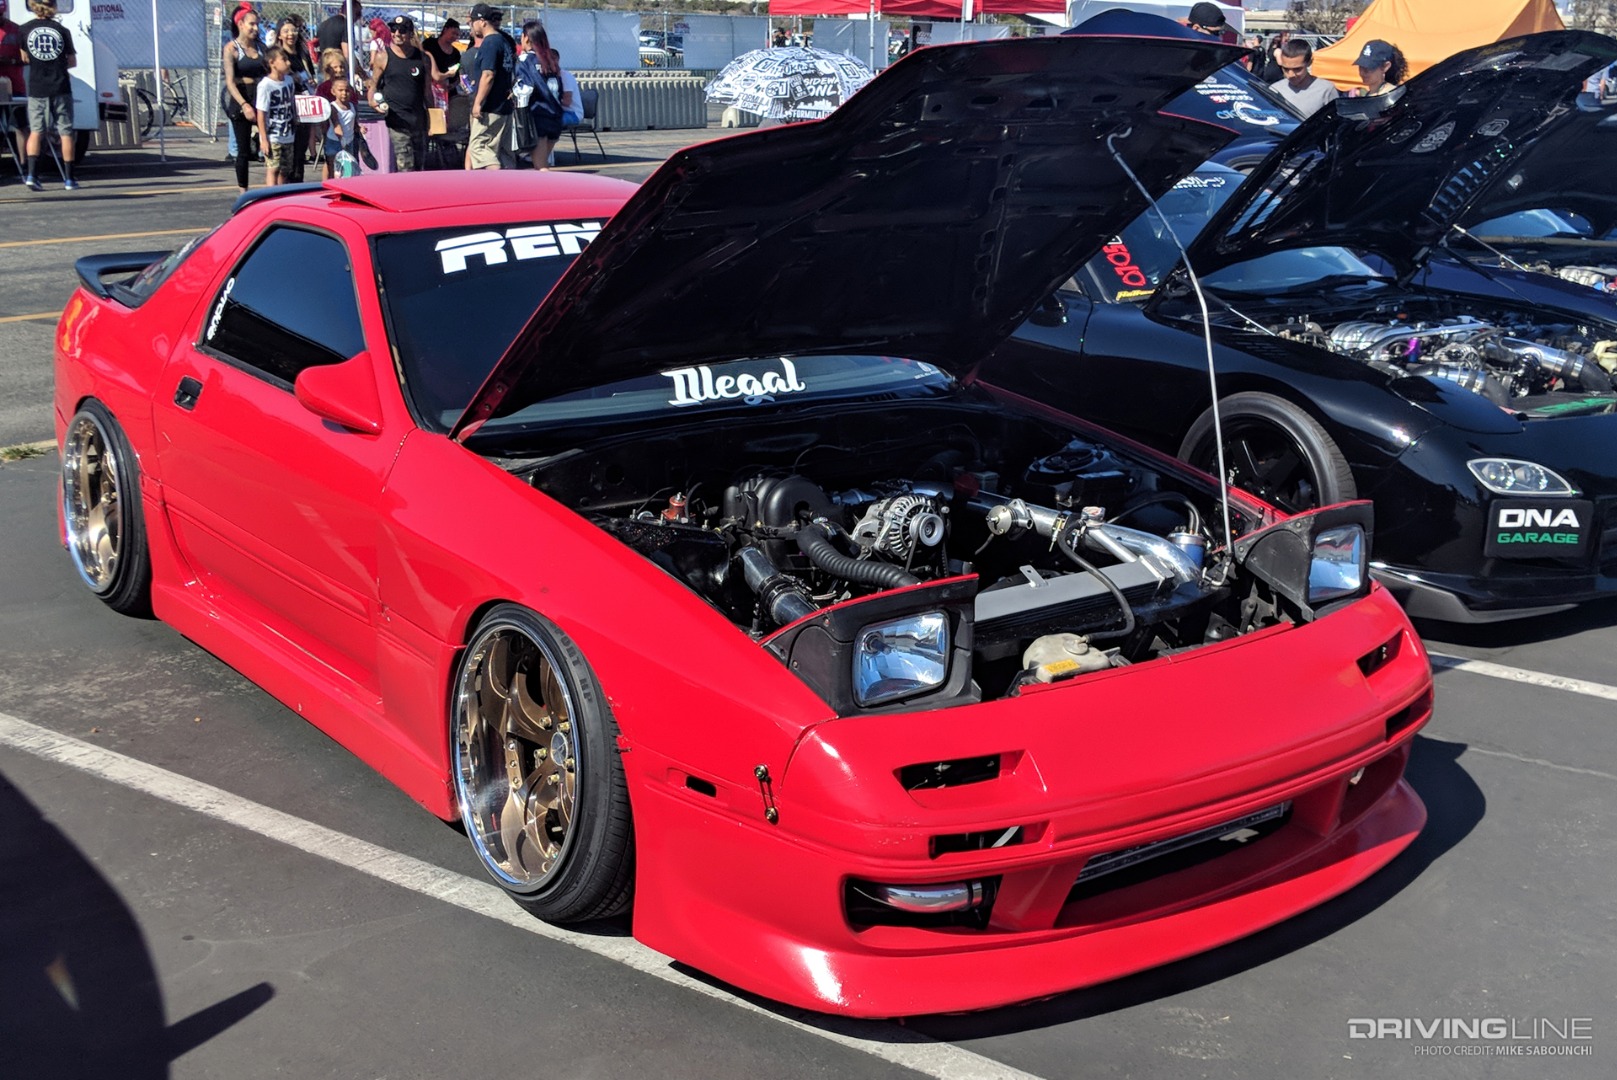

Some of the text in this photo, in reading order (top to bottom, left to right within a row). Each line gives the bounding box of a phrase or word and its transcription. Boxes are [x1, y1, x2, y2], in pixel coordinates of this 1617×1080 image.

[435, 222, 602, 274] REN
[660, 357, 807, 407] Illegal
[1498, 509, 1580, 528] DNA
[1497, 532, 1579, 544] GARAGE
